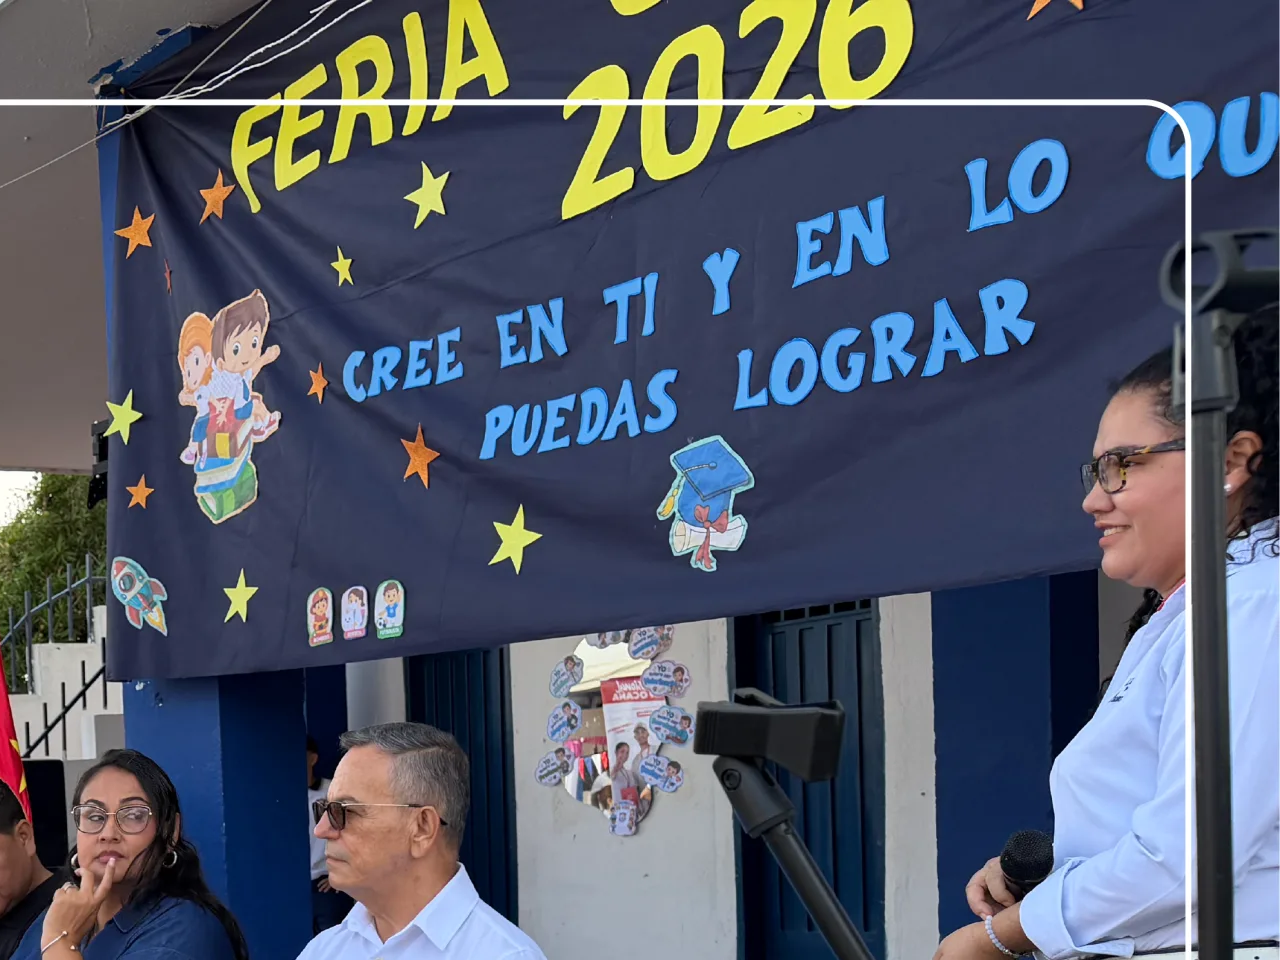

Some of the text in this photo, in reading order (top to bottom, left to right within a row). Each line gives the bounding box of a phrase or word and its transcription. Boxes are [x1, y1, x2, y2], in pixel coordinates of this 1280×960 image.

[231, 0, 510, 213] FERIA
[562, 0, 915, 219] 2026
[341, 325, 465, 403] CREE
[495, 296, 569, 370] EN
[601, 271, 660, 346] TI
[701, 247, 741, 317] Y
[791, 194, 891, 288] EN
[963, 137, 1070, 232] LO
[478, 277, 1038, 460] PUEDAS LOGRAR
